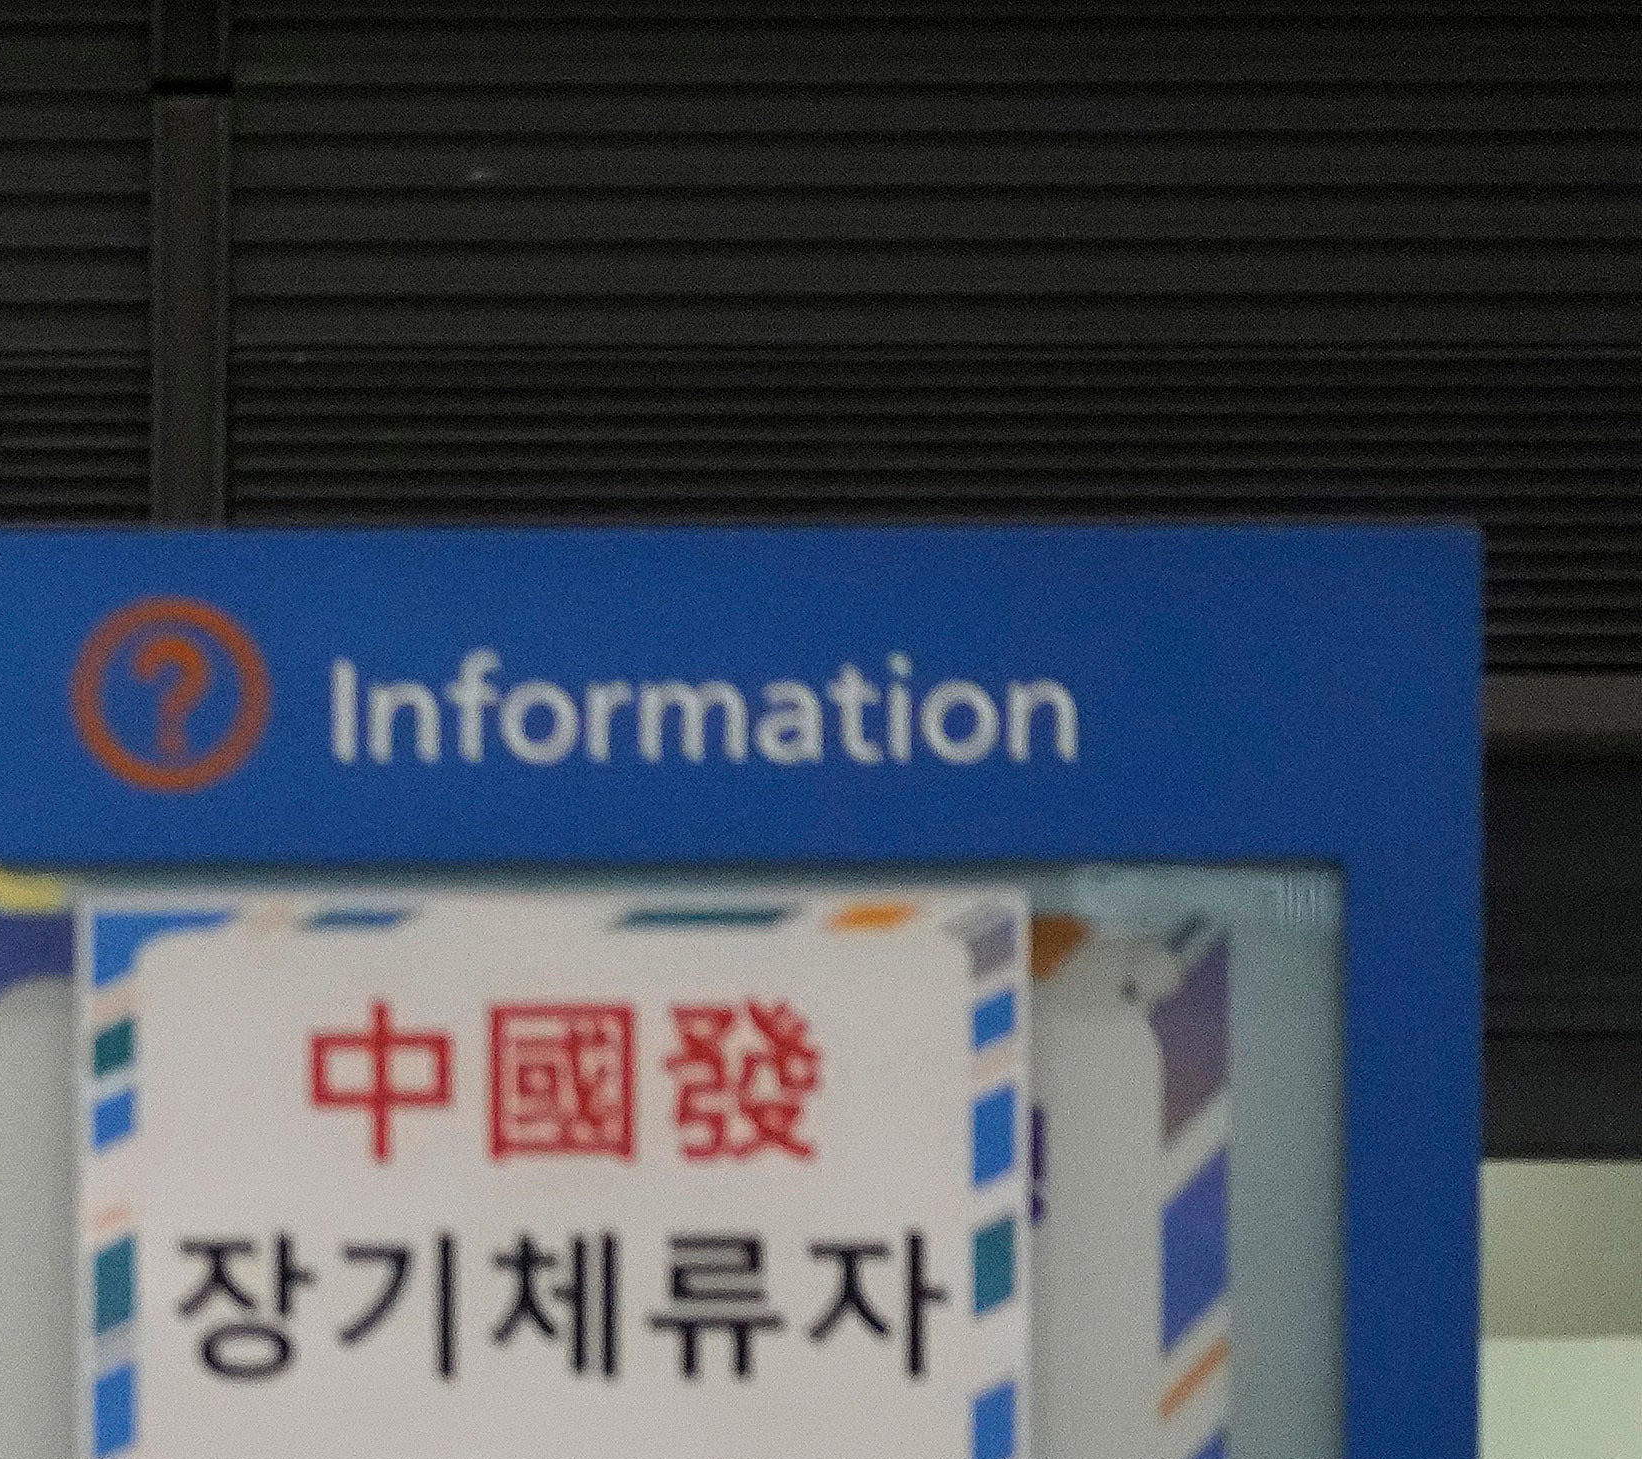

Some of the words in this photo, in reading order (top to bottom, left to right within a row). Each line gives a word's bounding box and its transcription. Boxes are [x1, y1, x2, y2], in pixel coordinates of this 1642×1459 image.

[331, 652, 1077, 764] Information
[307, 1000, 823, 1164] 中國發
[175, 1232, 949, 1380] 장기체류자
